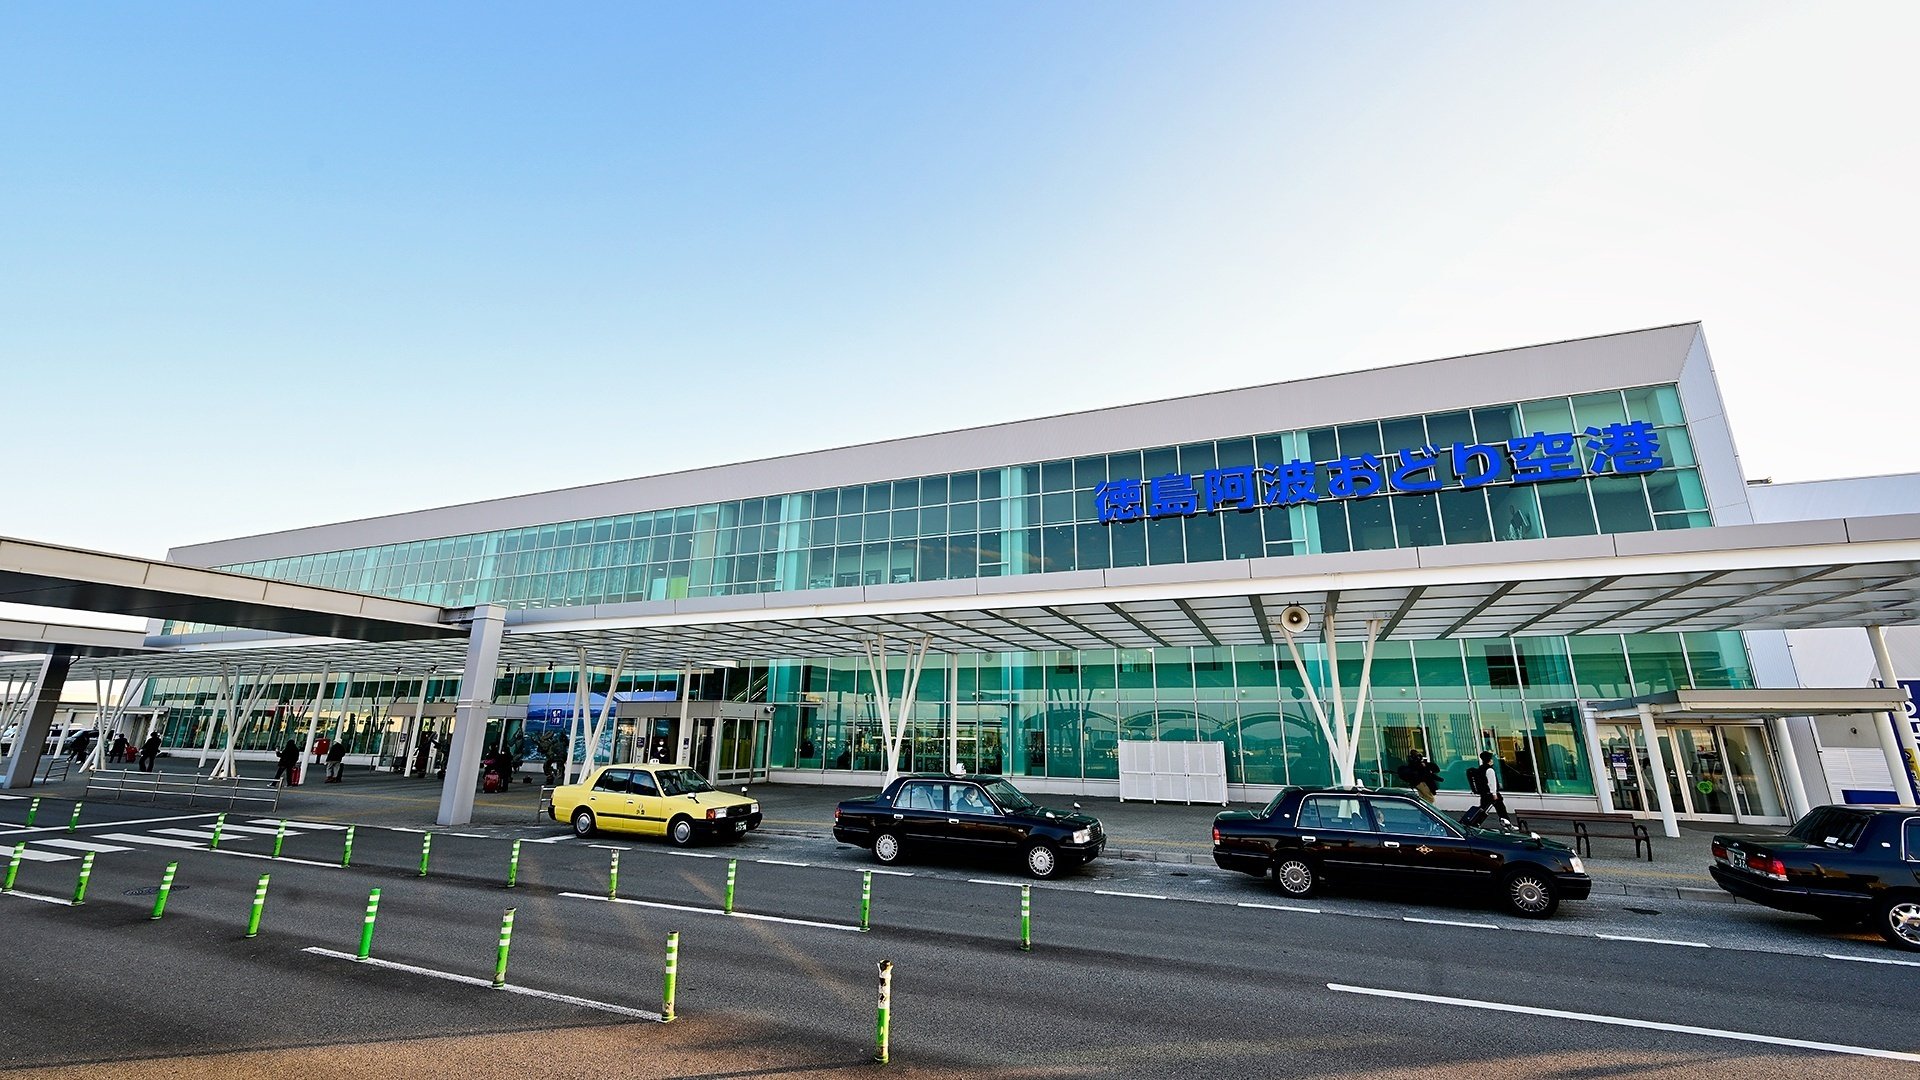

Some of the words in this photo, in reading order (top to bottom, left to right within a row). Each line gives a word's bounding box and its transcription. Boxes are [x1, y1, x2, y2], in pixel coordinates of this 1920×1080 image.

[1095, 421, 1663, 523] 徳島阿波おどり空港
